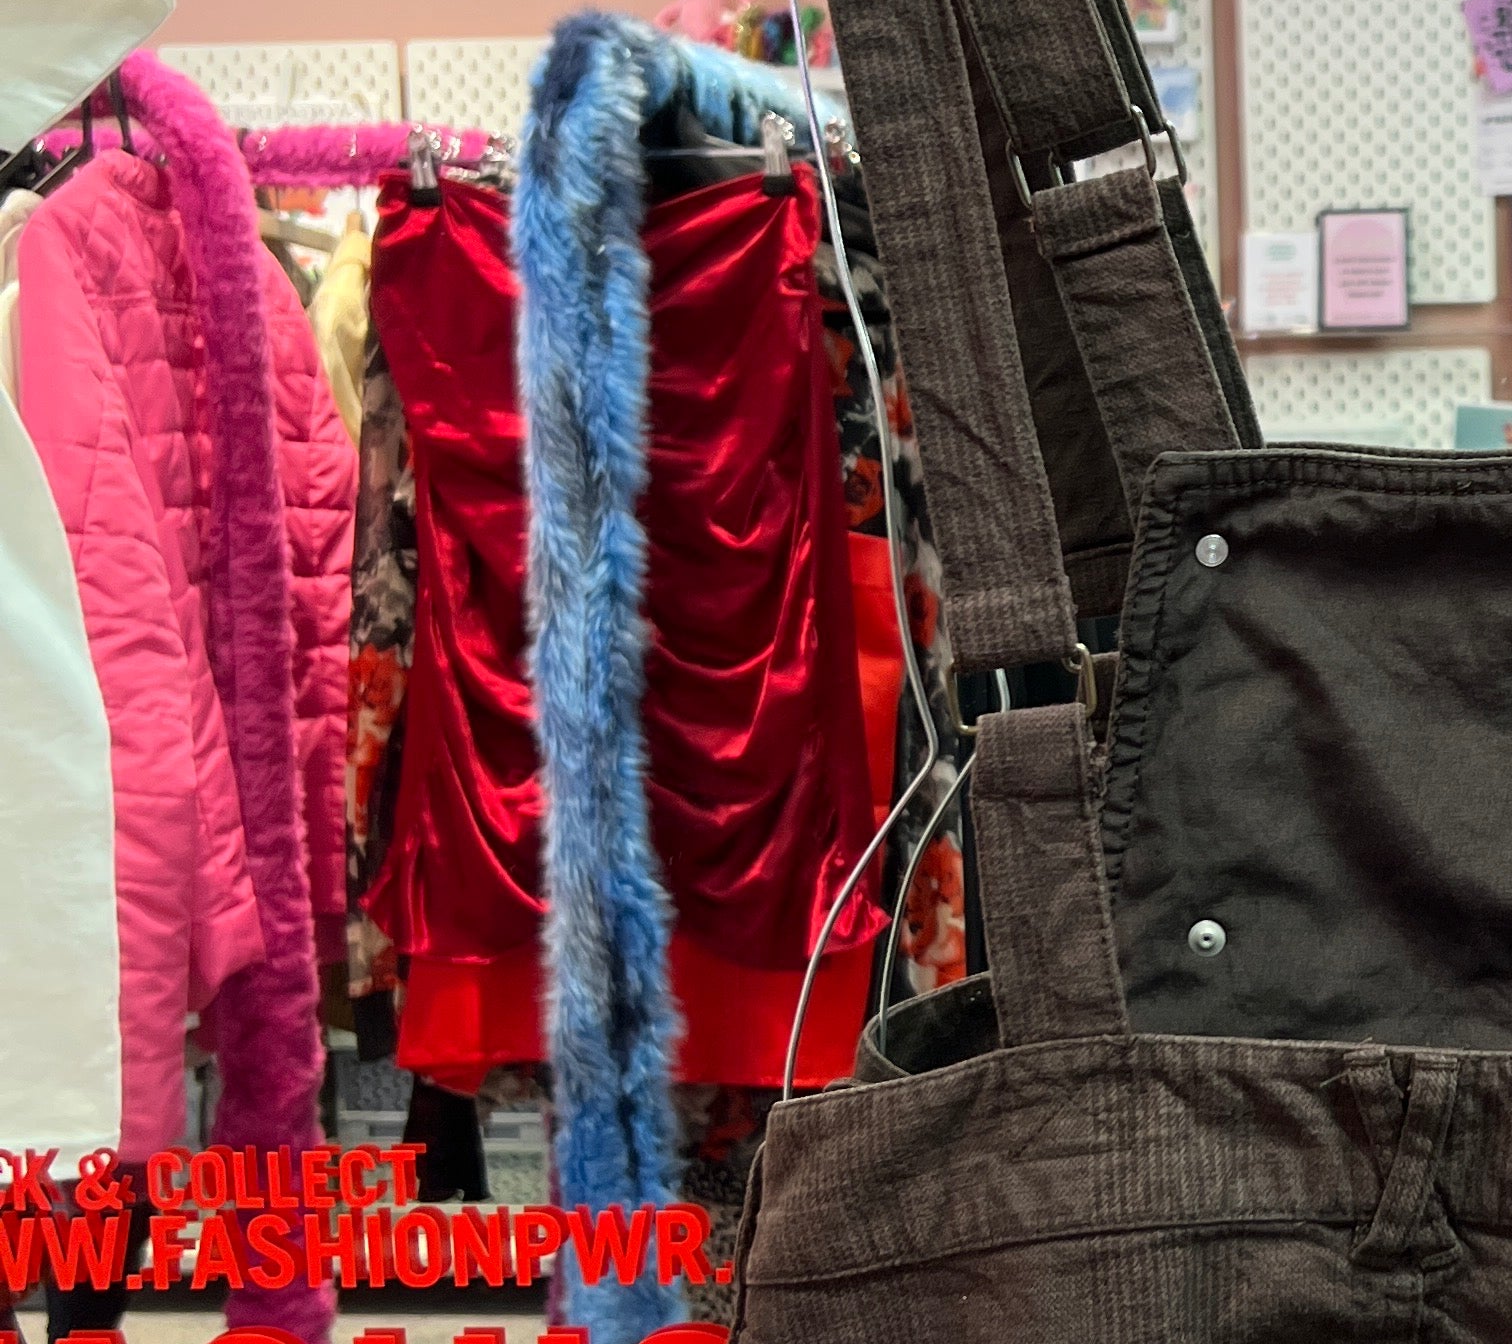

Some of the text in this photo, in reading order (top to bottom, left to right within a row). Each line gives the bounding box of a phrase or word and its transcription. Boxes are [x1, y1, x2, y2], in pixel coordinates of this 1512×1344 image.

[0, 1149, 417, 1211] K & COLLECT
